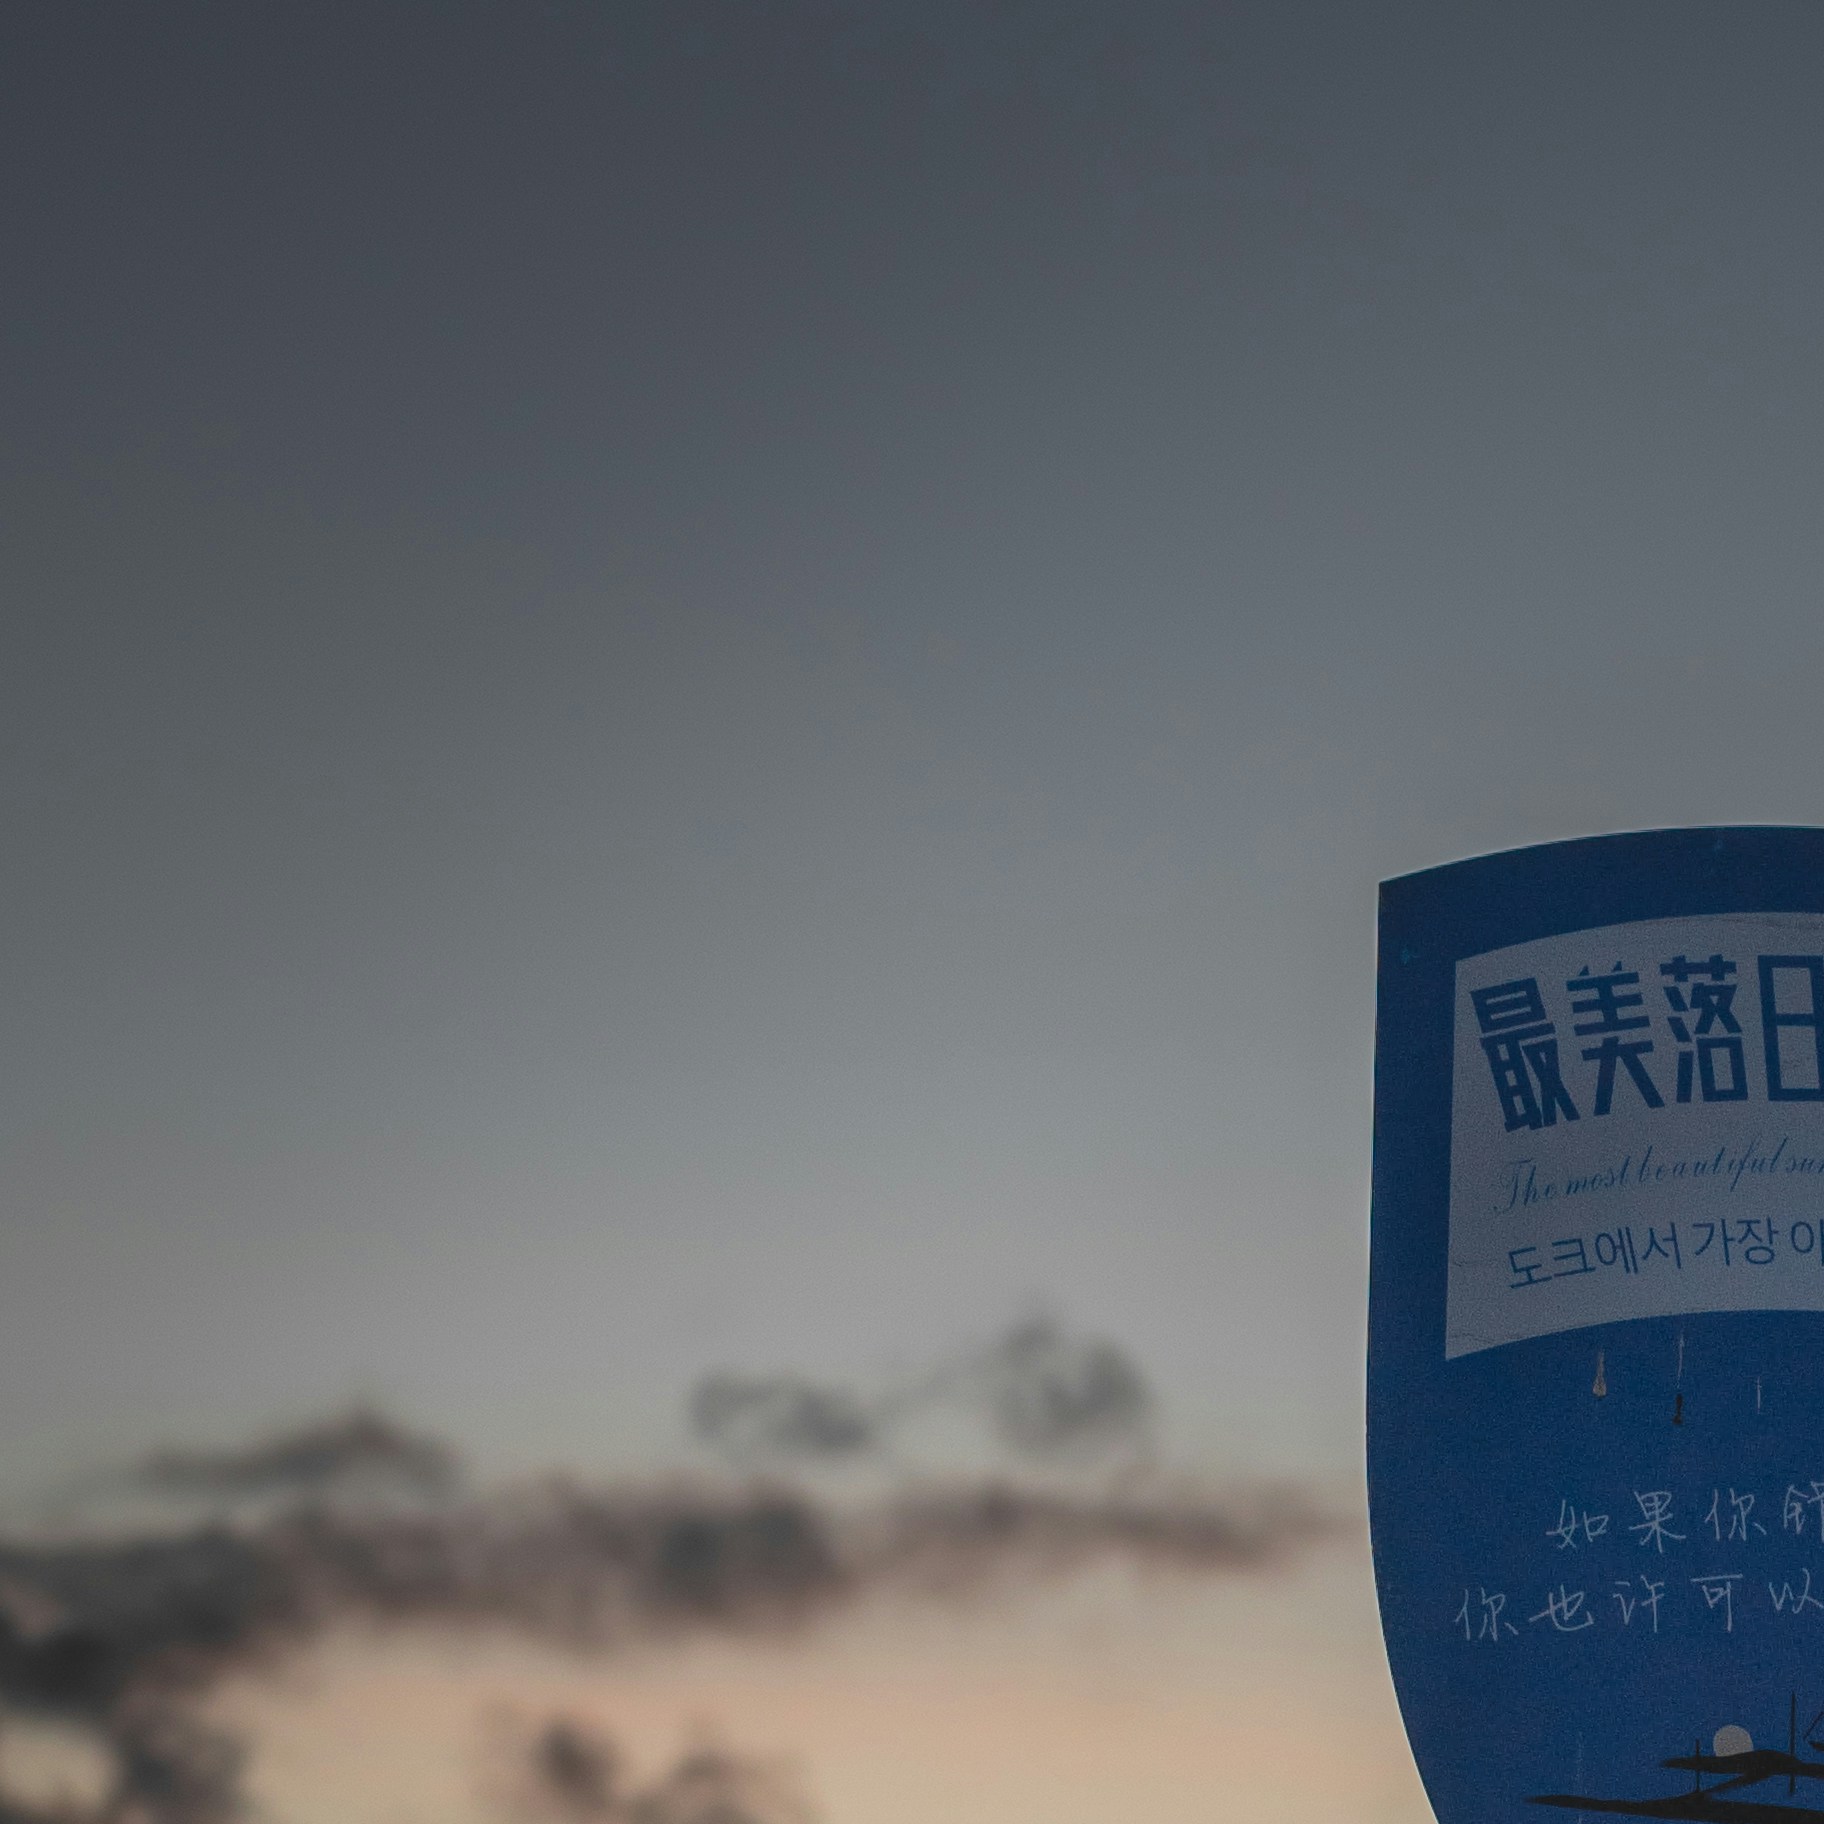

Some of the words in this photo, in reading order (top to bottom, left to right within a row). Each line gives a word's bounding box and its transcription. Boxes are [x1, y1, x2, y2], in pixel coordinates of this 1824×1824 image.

[1492, 1157, 1557, 1215] The
[1565, 1155, 1631, 1196] most
[1637, 1133, 1790, 1192] beautiful
[1507, 1221, 1682, 1290] 도크에서
[1691, 1217, 1780, 1267] 가장
